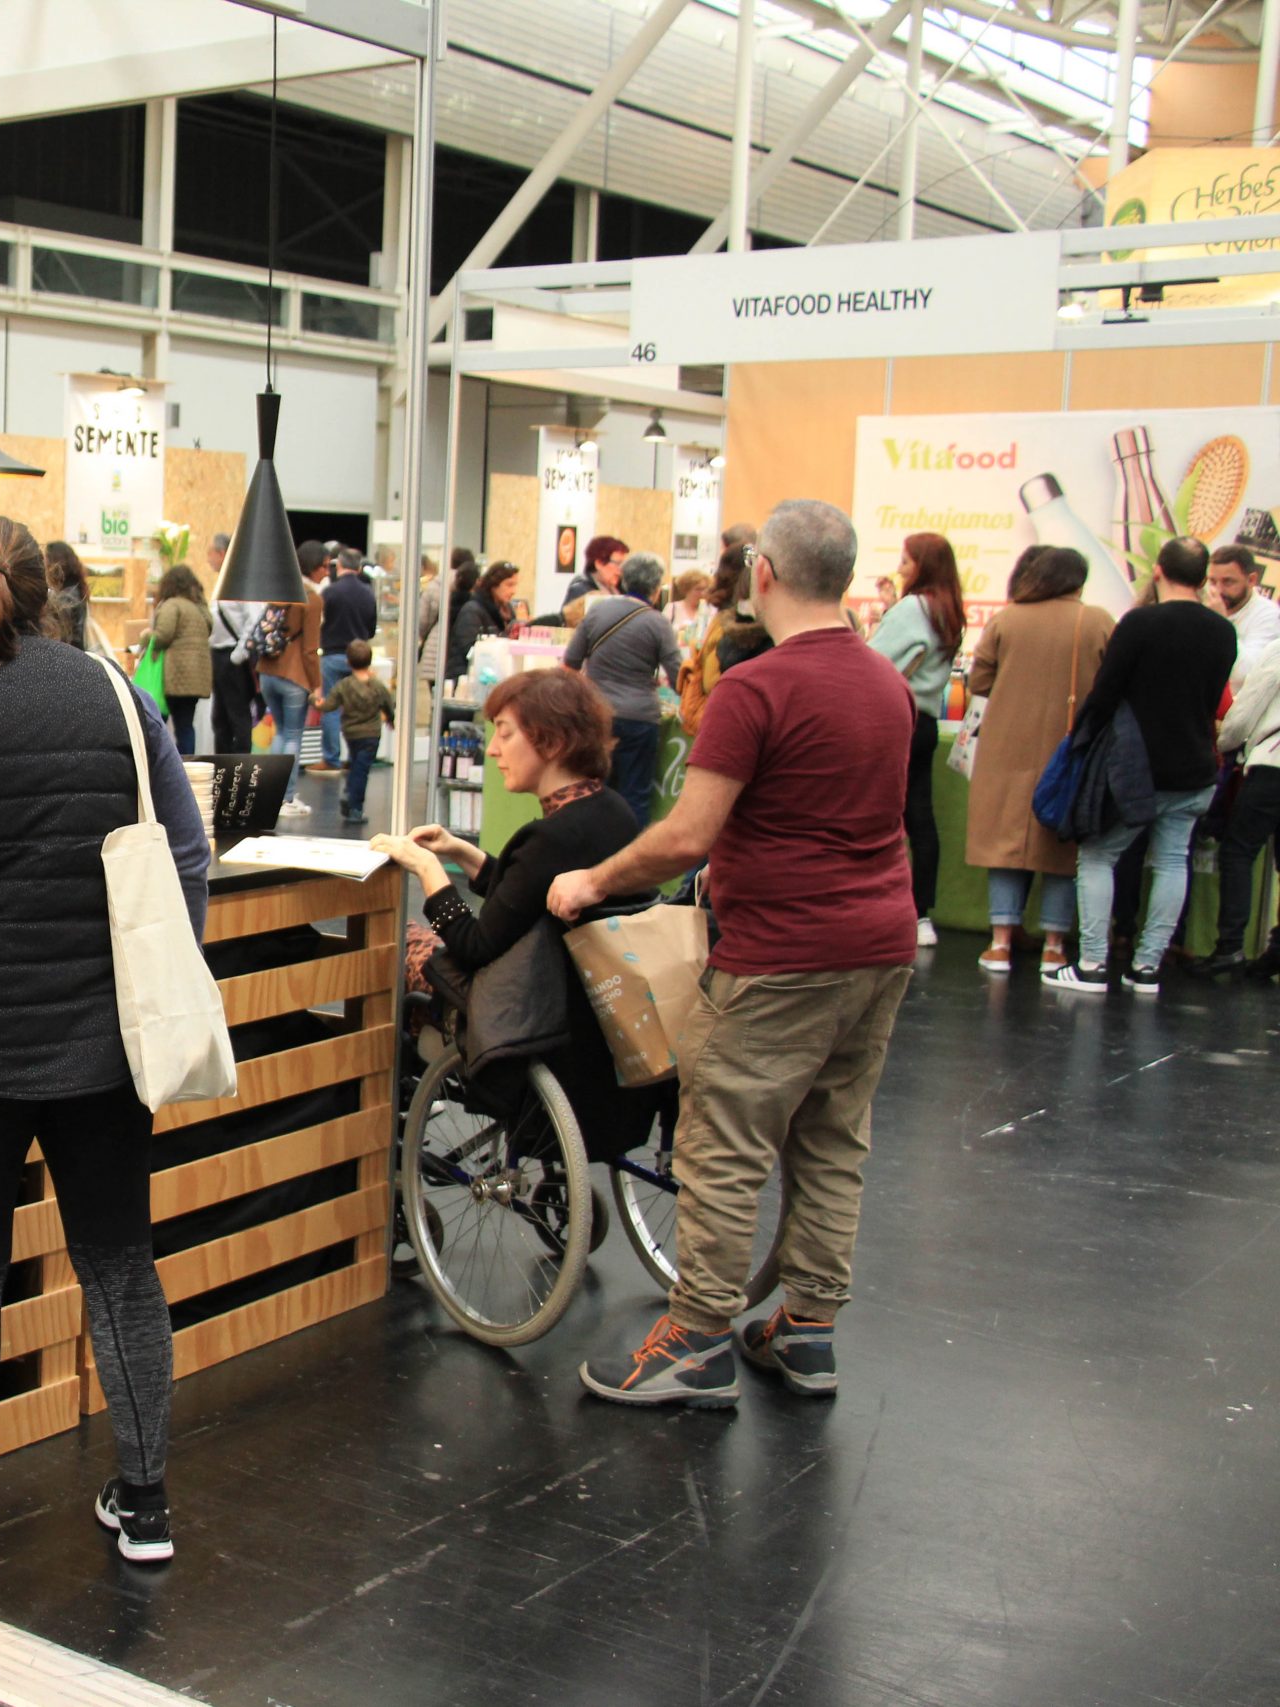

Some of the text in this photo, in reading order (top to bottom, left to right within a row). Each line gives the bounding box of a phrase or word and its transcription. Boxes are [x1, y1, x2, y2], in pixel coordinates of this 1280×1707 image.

[1194, 163, 1280, 209] Herbes
[732, 288, 933, 318] VITAFOOD HEALTHY
[631, 342, 657, 363] 46
[74, 424, 159, 458] SEMENTE
[101, 511, 129, 535] bio
[875, 505, 1014, 534] Trabajamos
